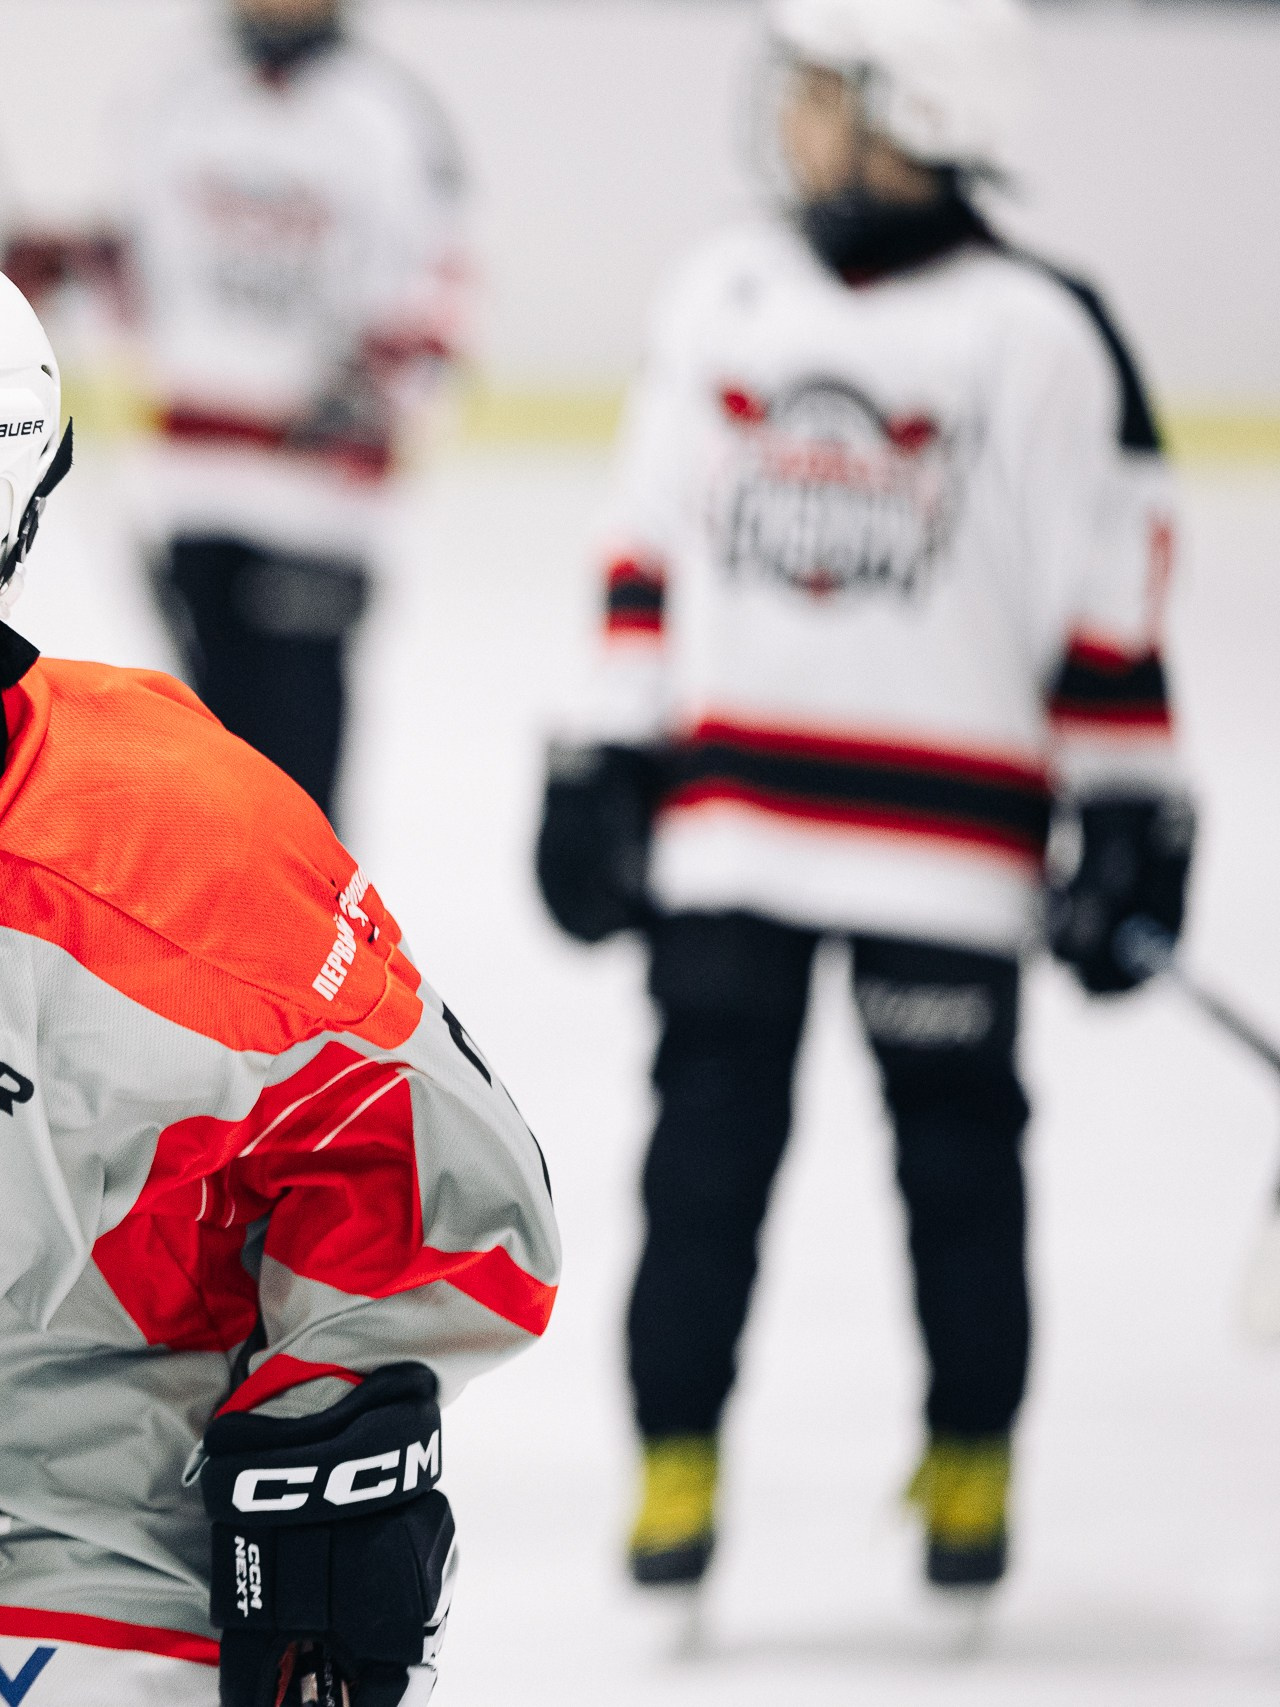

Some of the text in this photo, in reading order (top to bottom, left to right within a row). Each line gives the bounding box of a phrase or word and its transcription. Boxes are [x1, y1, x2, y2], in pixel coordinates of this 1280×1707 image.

[231, 1428, 440, 1513] CCM
[234, 1535, 249, 1618] NEXT
[247, 1542, 263, 1610] CCM
